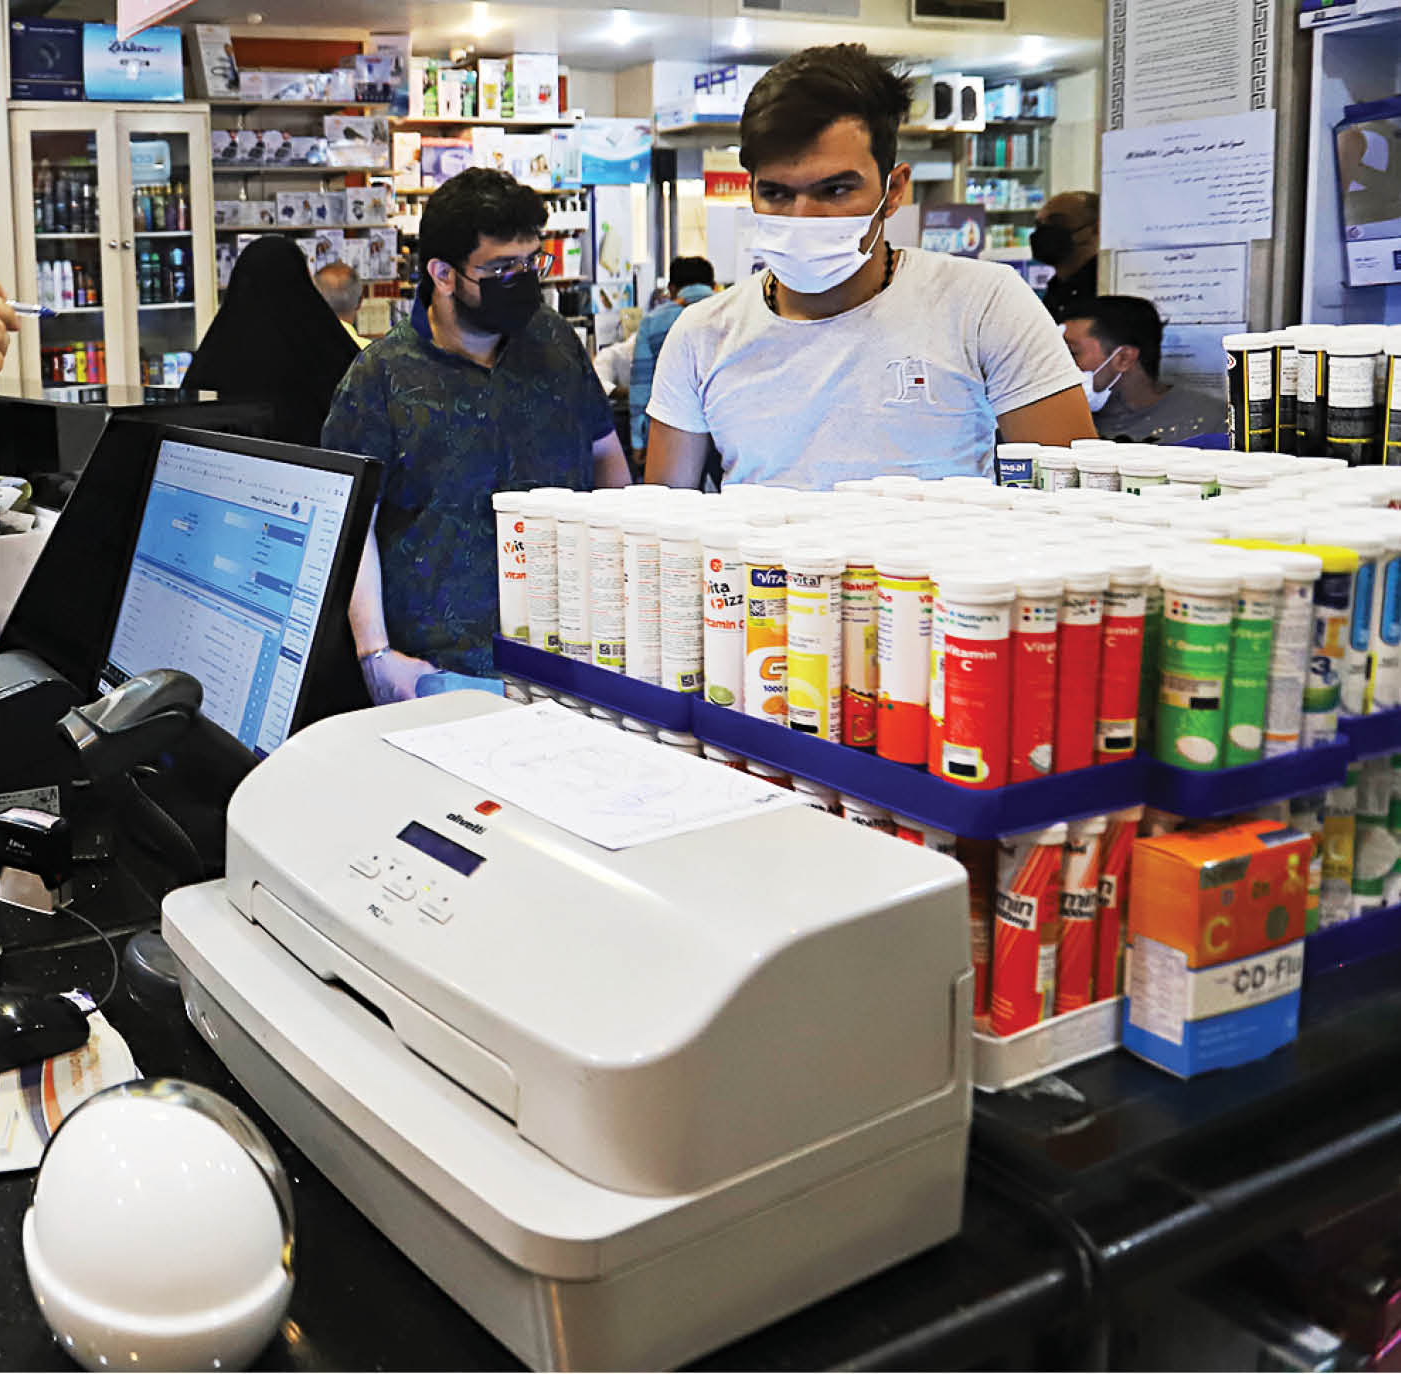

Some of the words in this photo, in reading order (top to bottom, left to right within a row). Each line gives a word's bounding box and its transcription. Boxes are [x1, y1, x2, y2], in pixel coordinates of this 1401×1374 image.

[960, 659, 973, 672] C
[446, 812, 487, 835] olivetti
[1204, 916, 1232, 954] C
